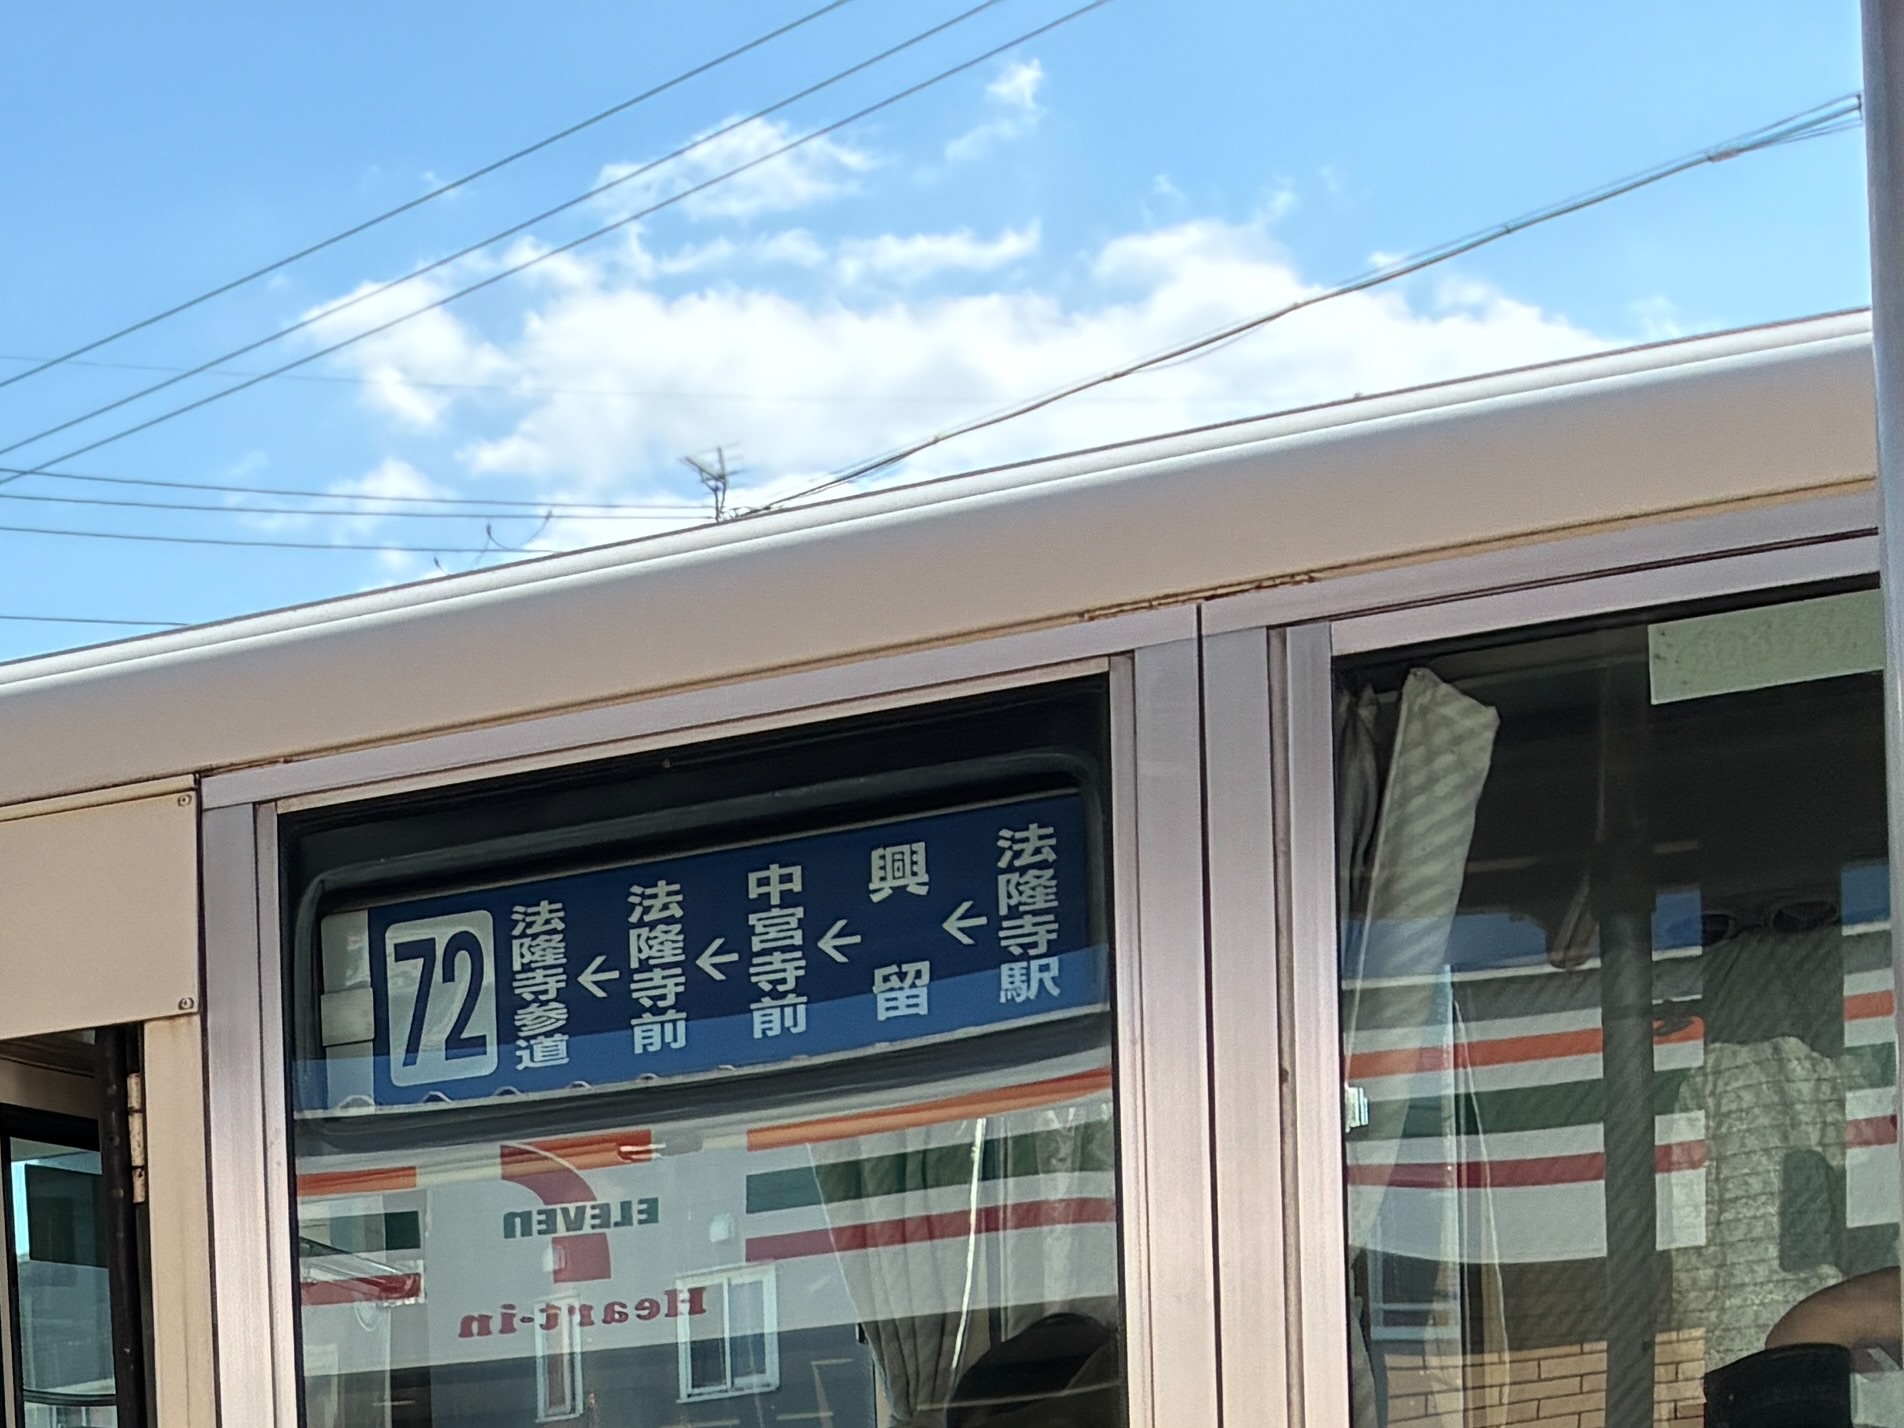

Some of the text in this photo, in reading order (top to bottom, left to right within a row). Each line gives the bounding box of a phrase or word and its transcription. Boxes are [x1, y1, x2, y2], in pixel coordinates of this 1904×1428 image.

[392, 929, 489, 1068] 72
[510, 899, 571, 1071] 法隆寺参道
[626, 879, 688, 1055] 法隆寺前
[747, 863, 809, 1039] 中宮寺前
[867, 840, 932, 1021] 興留
[995, 823, 1061, 1004] 法隆寺駅
